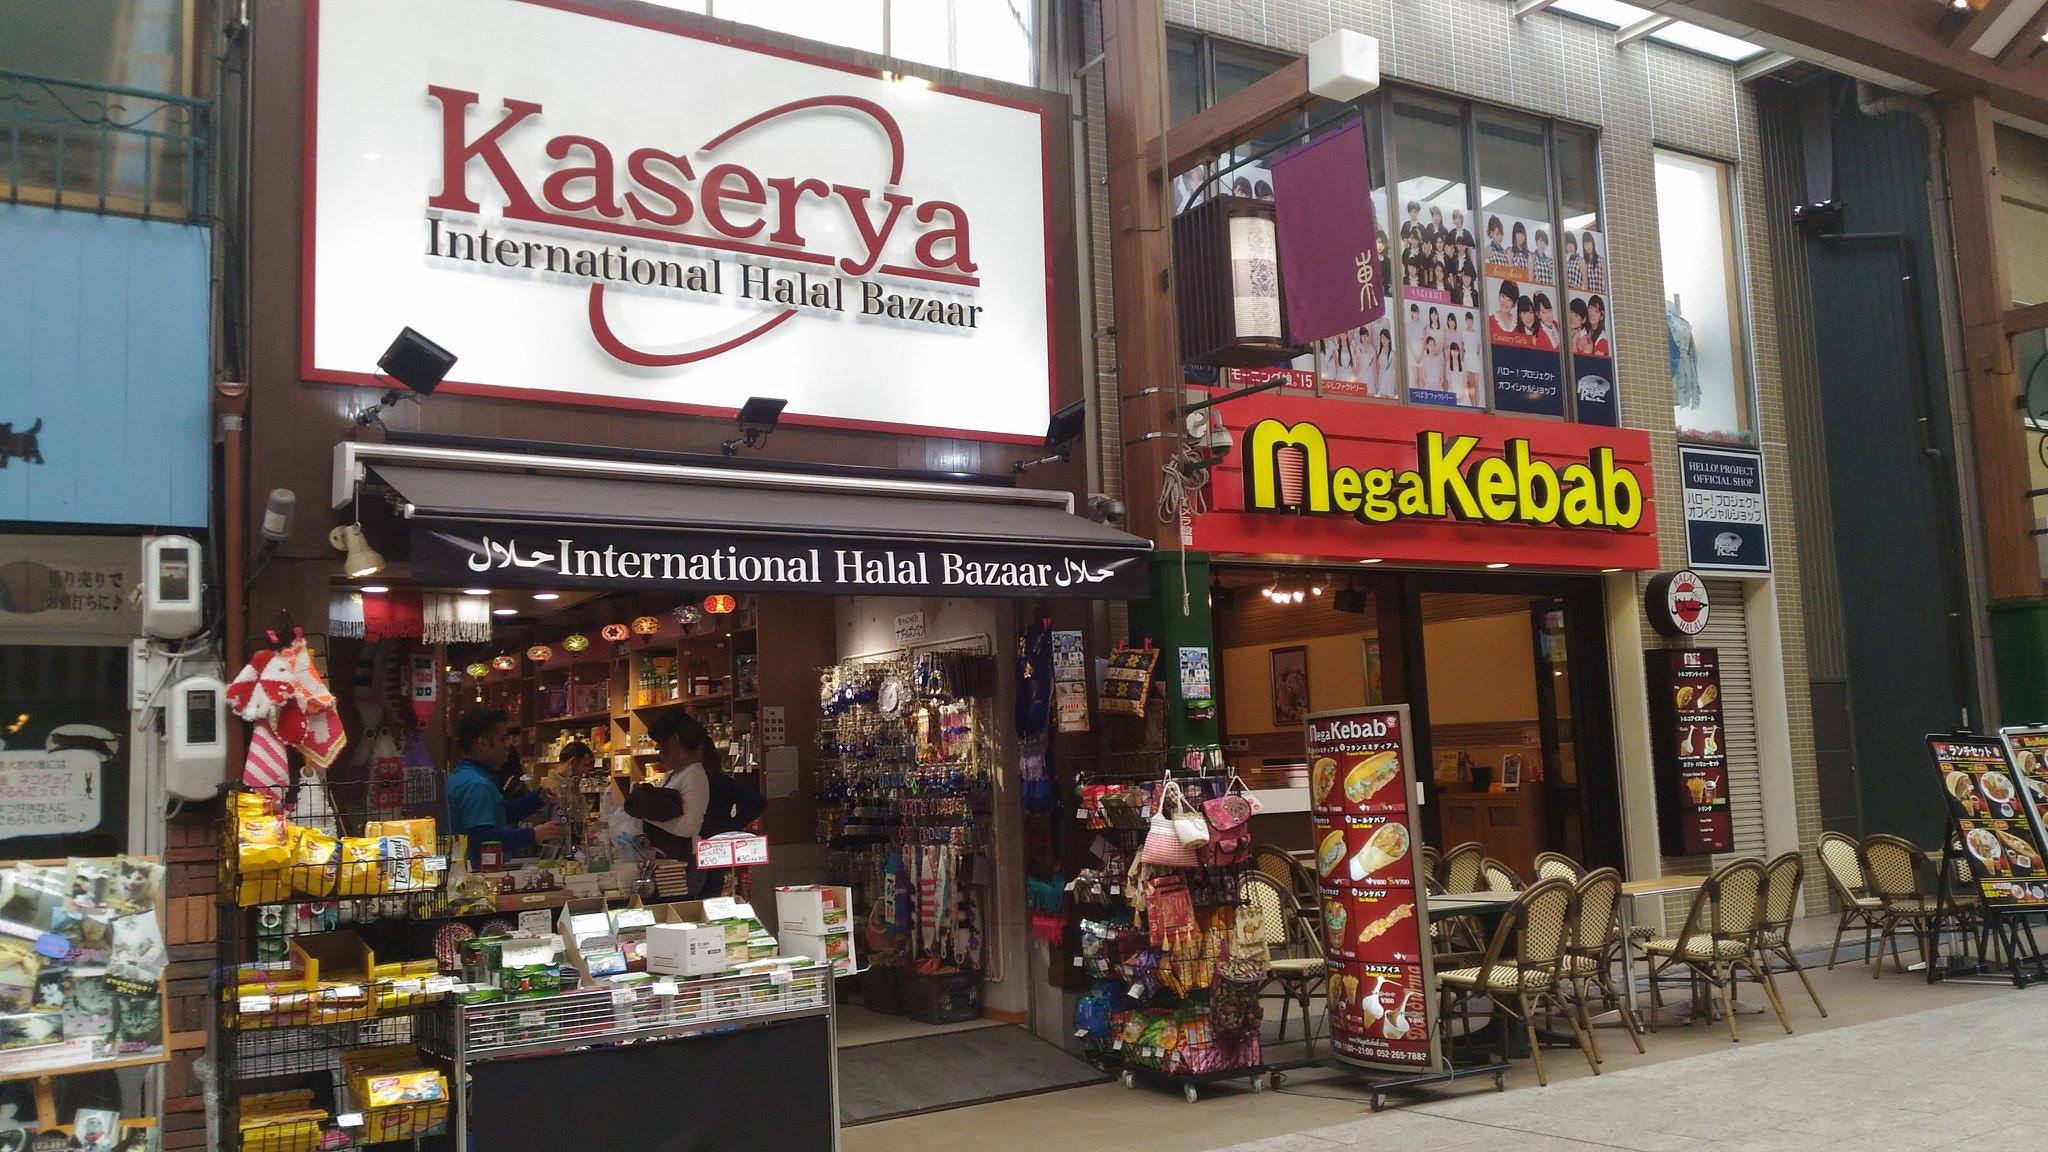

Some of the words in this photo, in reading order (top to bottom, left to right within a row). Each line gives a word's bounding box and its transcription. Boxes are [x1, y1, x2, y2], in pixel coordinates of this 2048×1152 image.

[427, 84, 979, 276] Kaserya
[428, 217, 722, 295] International
[740, 263, 845, 312] Halal
[861, 281, 983, 329] Bazaar
[1688, 461, 1719, 473] HELLO!
[1720, 464, 1755, 477] PROJECT
[1693, 474, 1733, 487] OFFICIAL
[1733, 477, 1754, 487] SHOP
[468, 535, 557, 573] حلال
[557, 539, 819, 585] International
[834, 549, 929, 585] Halal
[941, 553, 1052, 588] Bazaar
[1054, 556, 1115, 587] حلال
[1680, 620, 1704, 633] HALAL
